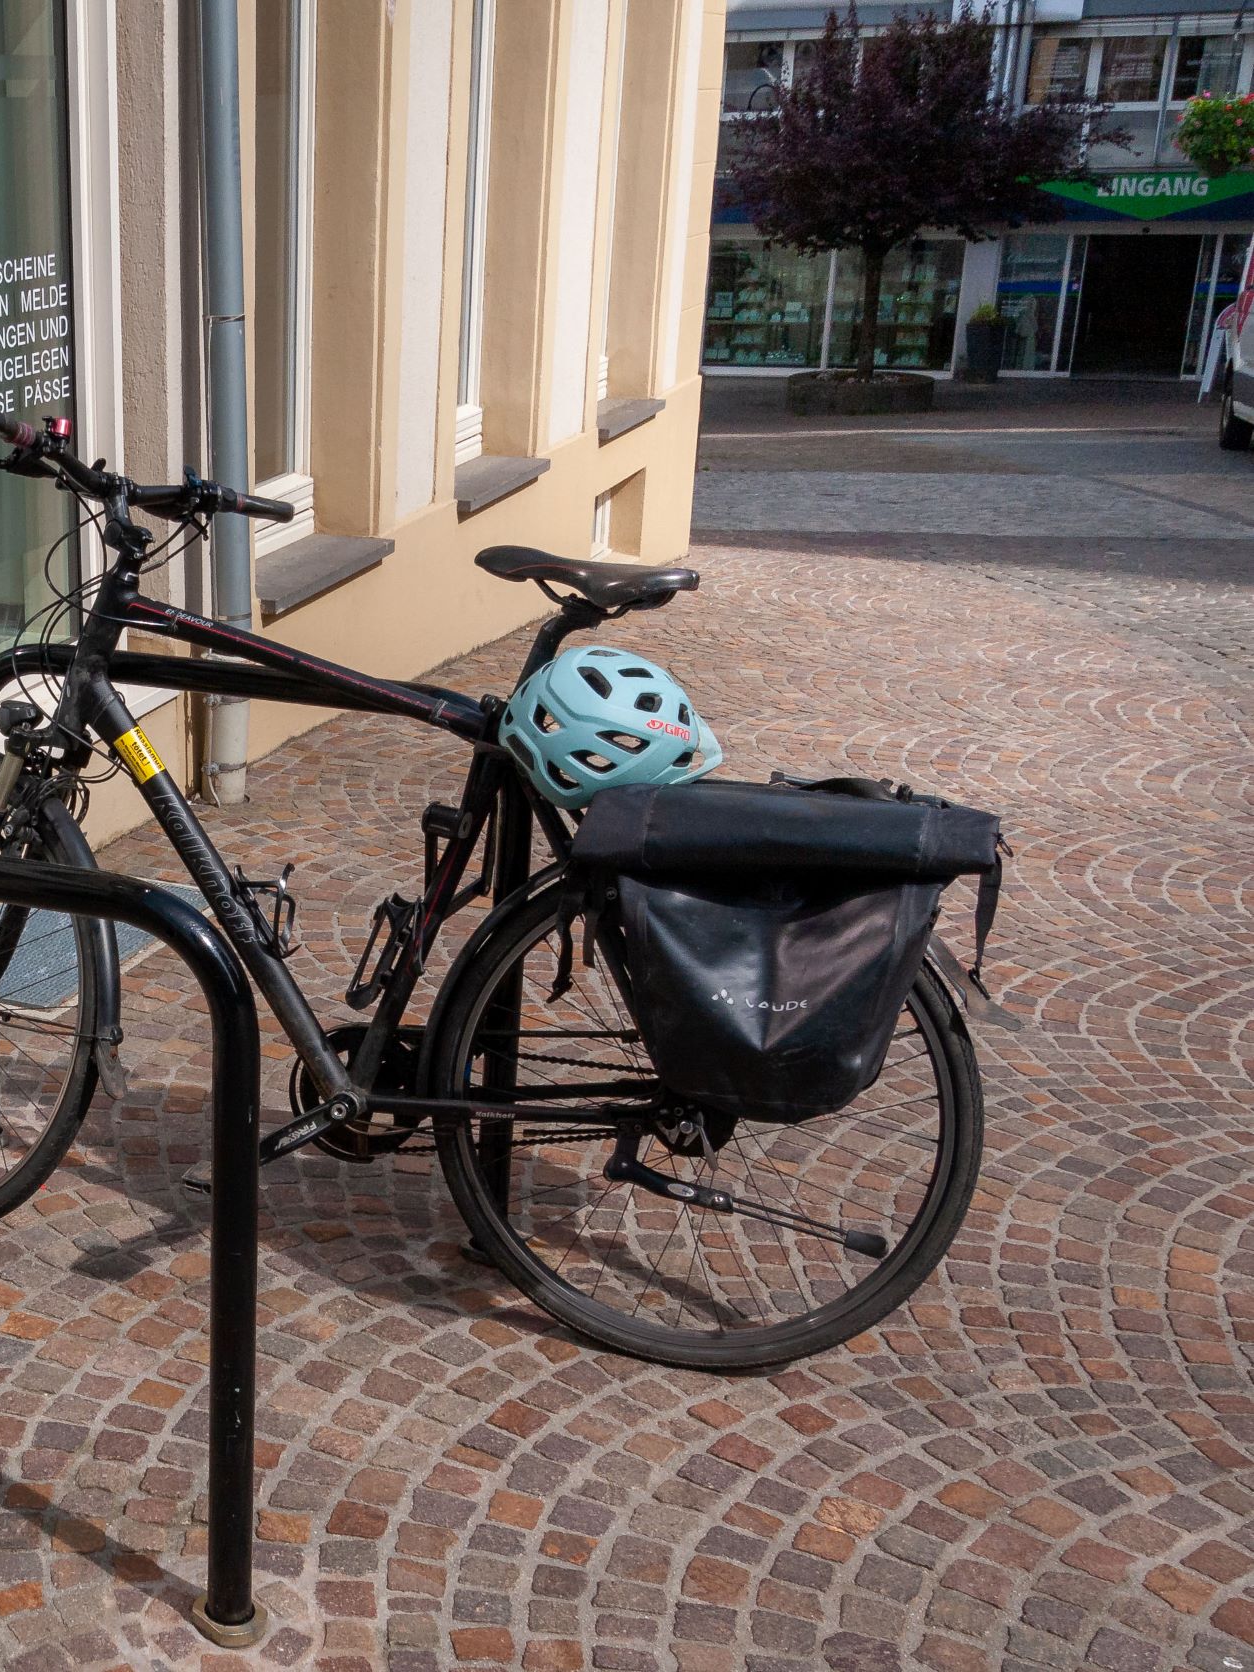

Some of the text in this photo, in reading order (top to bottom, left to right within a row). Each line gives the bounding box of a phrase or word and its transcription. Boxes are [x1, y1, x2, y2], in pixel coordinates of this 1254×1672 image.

[20, 284, 68, 314] MELDE
[40, 315, 69, 342] UND
[24, 376, 70, 408] PÄSSE
[665, 723, 691, 741] GIRO
